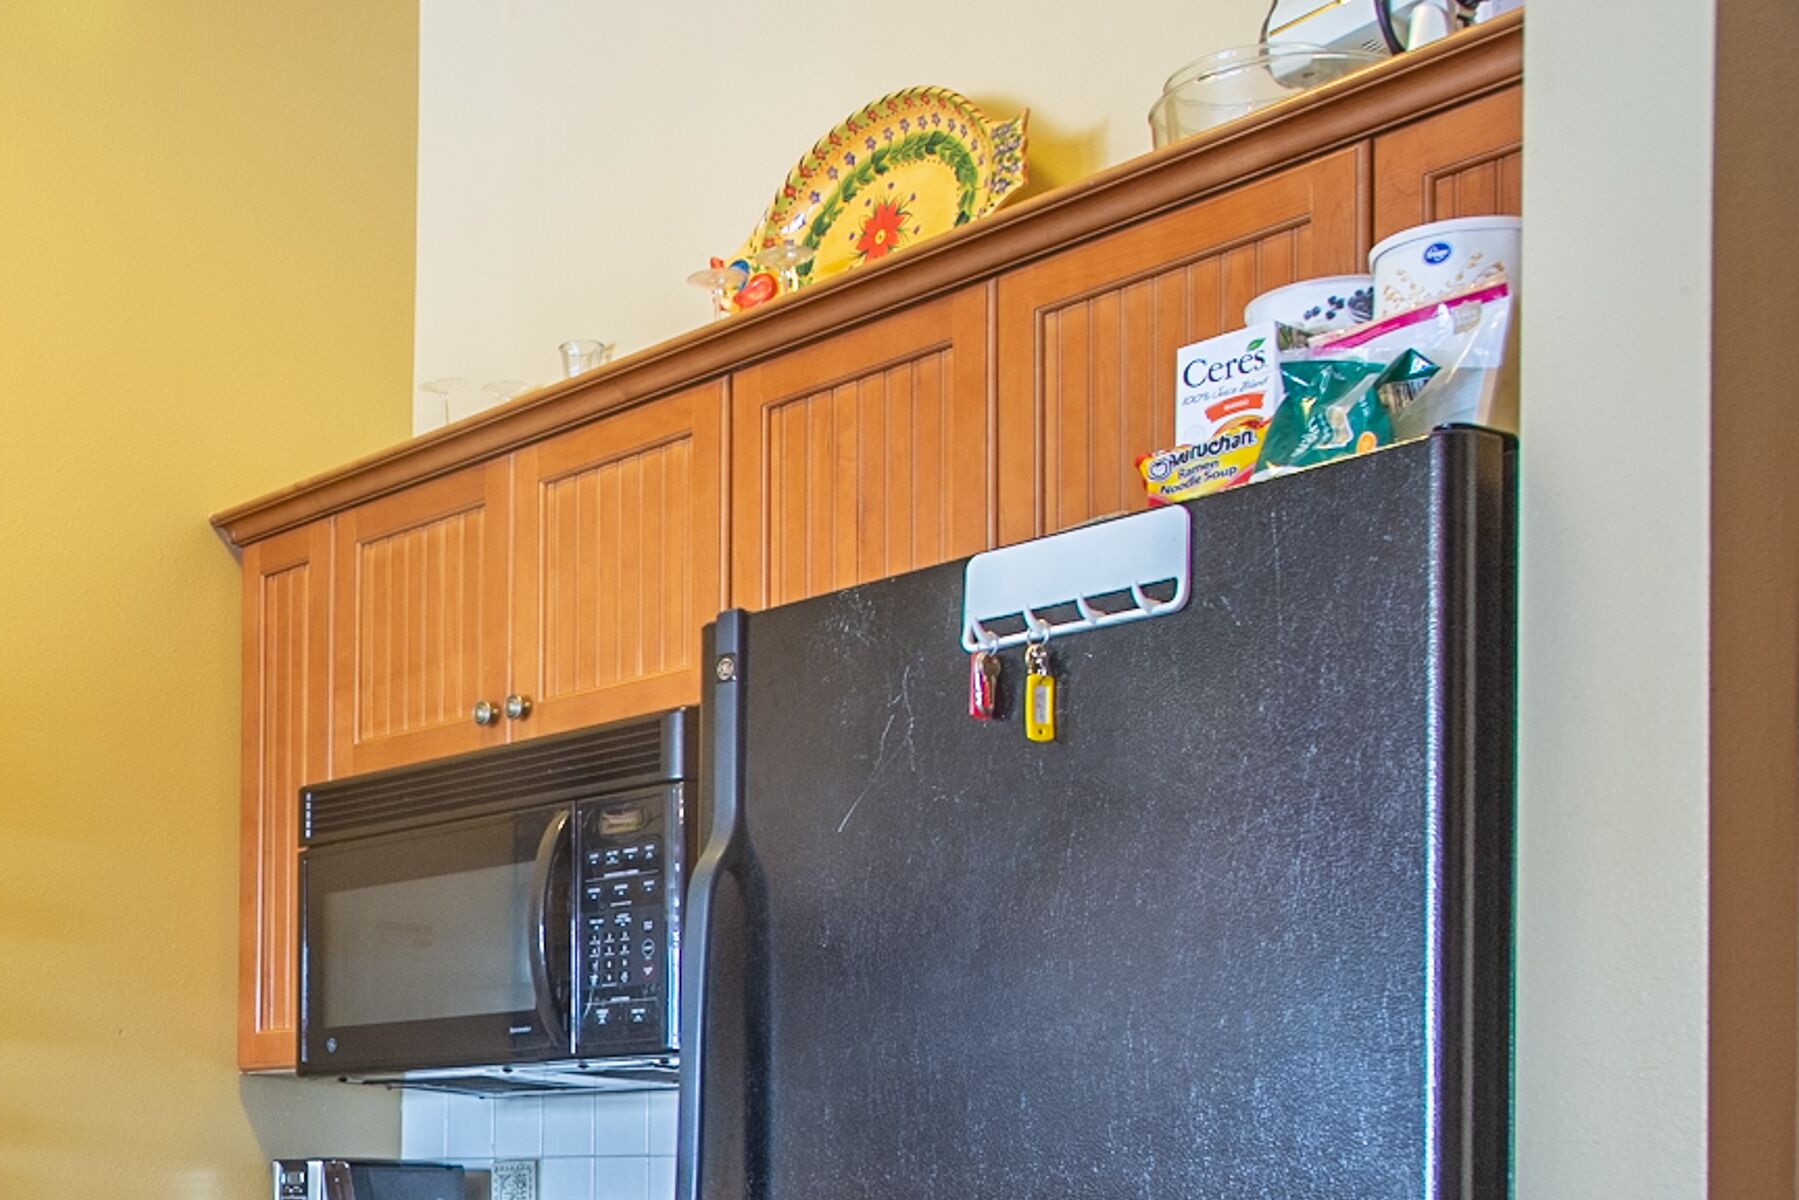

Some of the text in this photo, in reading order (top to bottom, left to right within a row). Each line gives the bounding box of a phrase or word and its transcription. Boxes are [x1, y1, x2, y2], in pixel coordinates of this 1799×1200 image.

[1182, 349, 1267, 388] Ceres
[1160, 466, 1237, 494] Noodle Soup
[1178, 460, 1220, 479] Ramen
